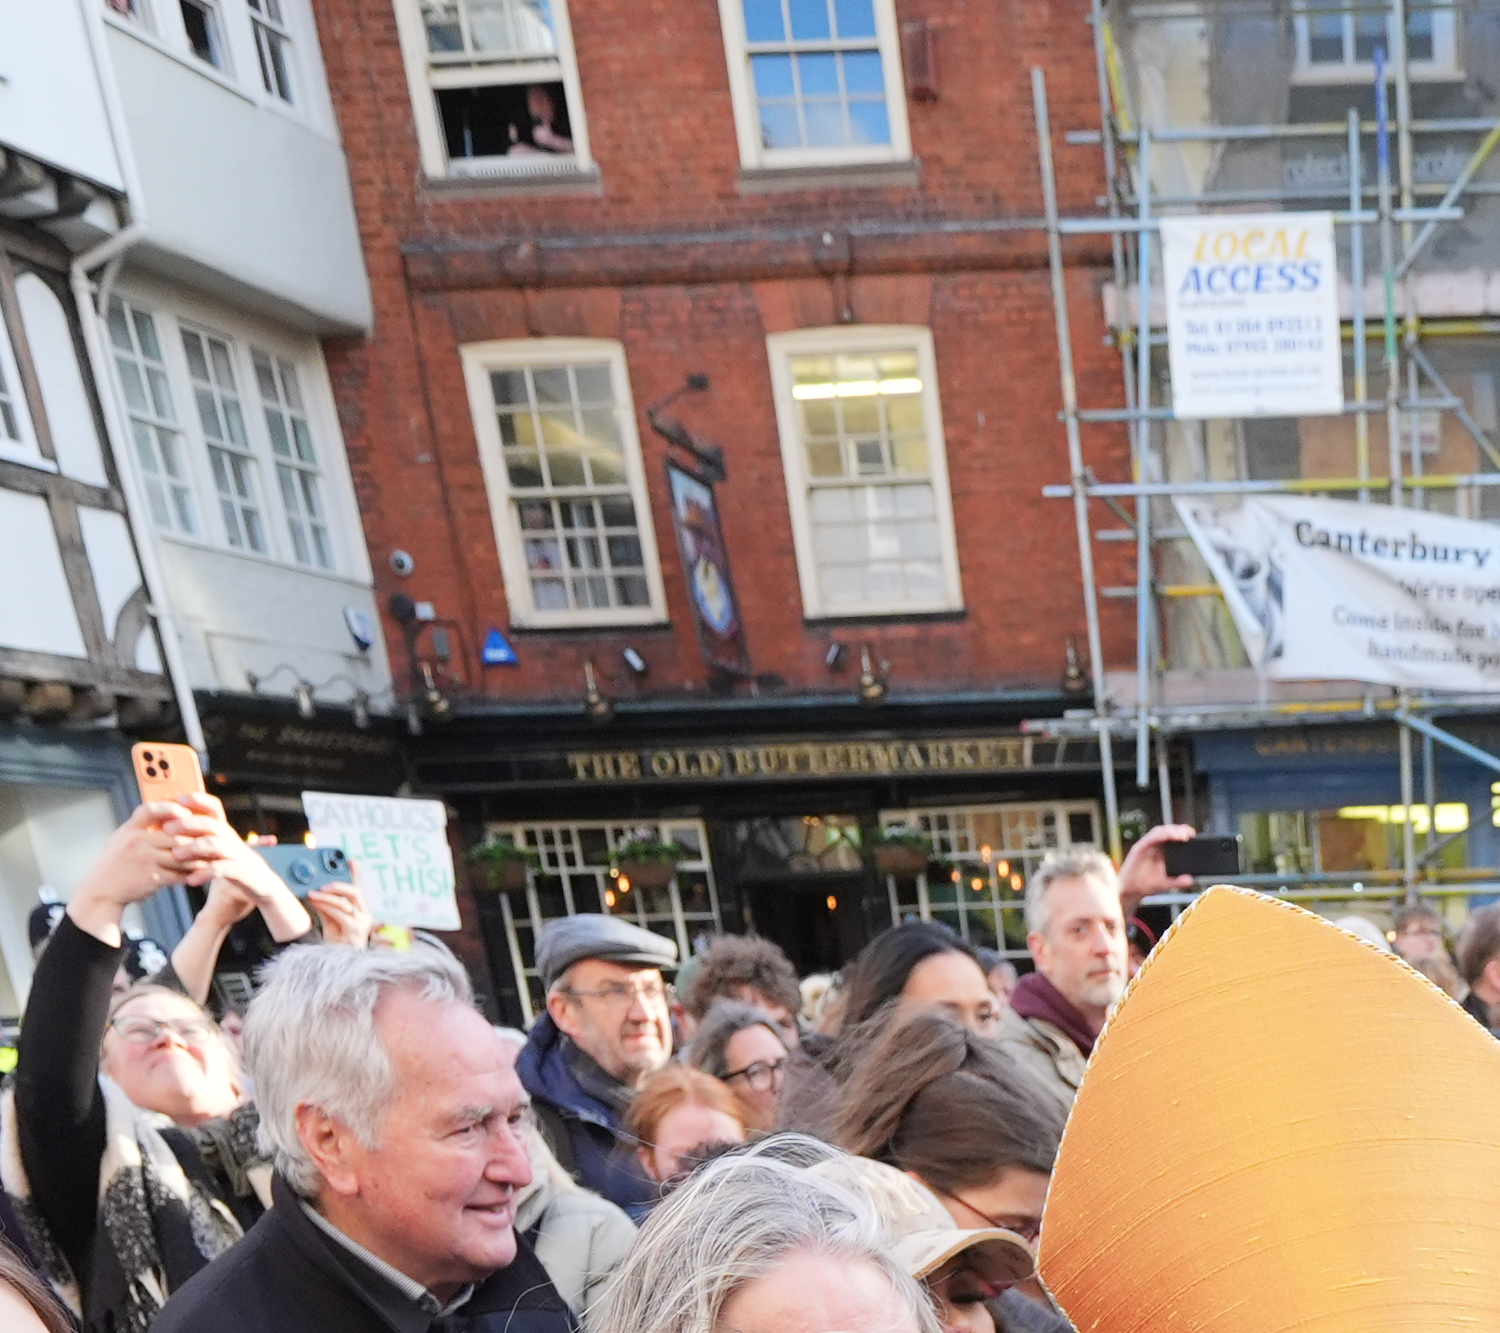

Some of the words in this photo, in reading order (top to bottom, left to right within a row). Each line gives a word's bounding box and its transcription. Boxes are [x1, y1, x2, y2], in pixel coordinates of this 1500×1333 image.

[1194, 228, 1311, 263] LOCAL
[1180, 260, 1322, 294] ACCESS
[1296, 519, 1491, 568] Canterbury
[1333, 606, 1389, 630] Come
[1393, 612, 1452, 637] inside
[1456, 620, 1487, 639] for
[1368, 640, 1473, 665] handmade
[569, 751, 640, 780] THE
[651, 748, 723, 778] OLD
[729, 739, 1023, 776] BUTTERMARKET
[341, 831, 432, 864] LET'S
